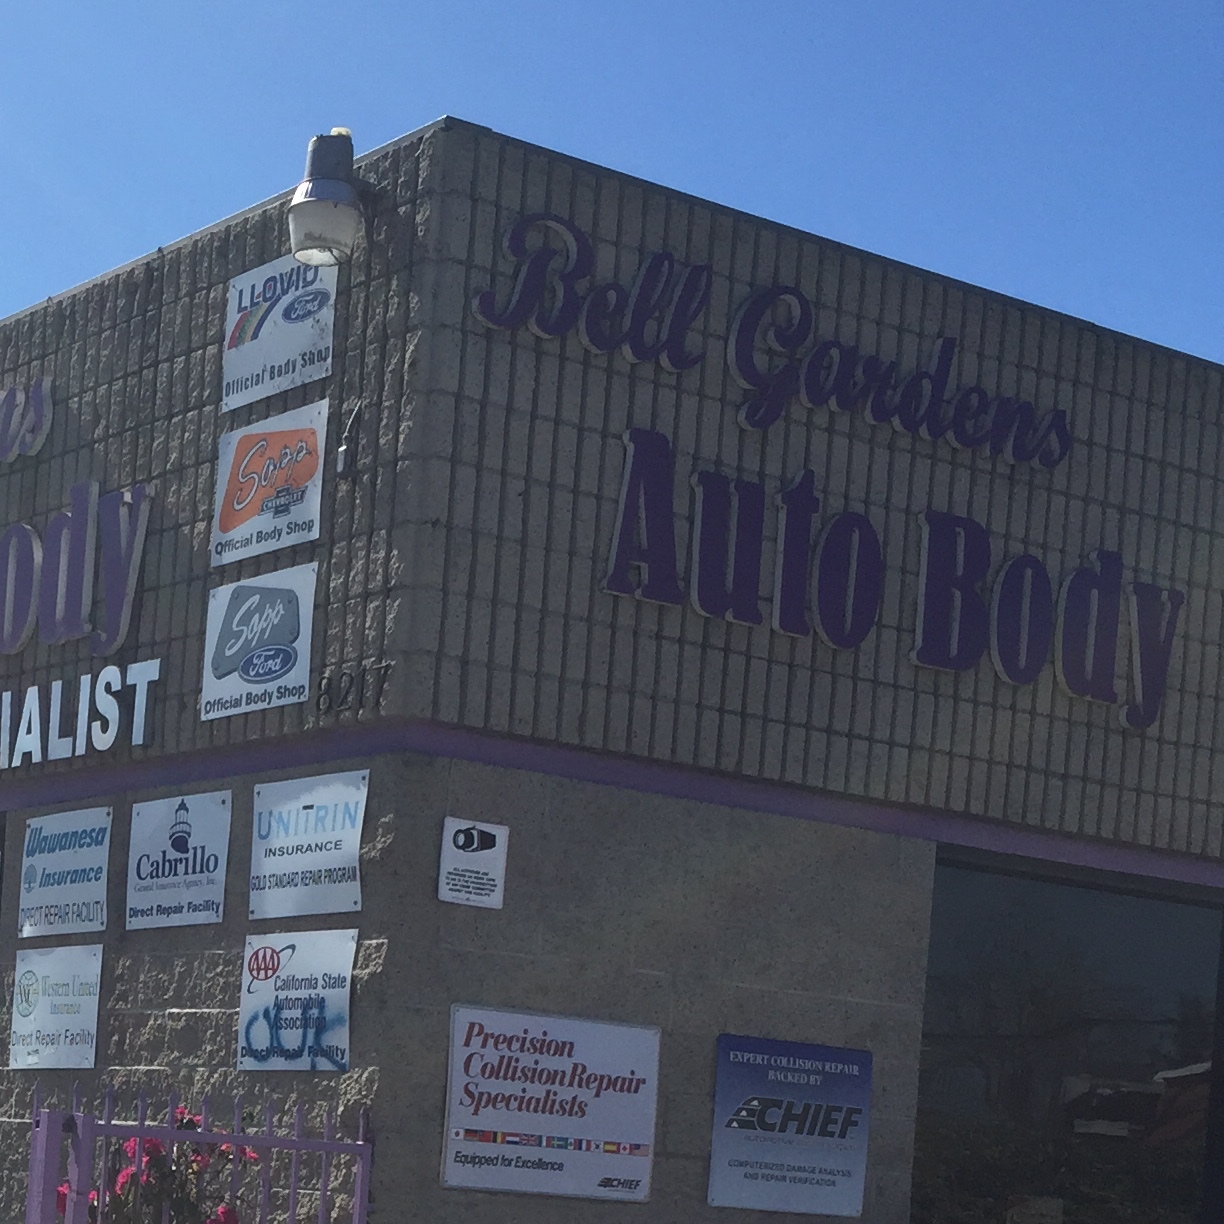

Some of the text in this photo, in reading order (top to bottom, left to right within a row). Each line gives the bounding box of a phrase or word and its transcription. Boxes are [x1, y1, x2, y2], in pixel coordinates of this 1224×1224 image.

[290, 297, 321, 319] Ford
[474, 212, 1074, 468] Bell Gardens
[225, 345, 331, 398] Official Body Shop
[215, 518, 315, 556] Official Body Shop
[602, 427, 1185, 729] Auto Body
[225, 594, 286, 657] Sapp
[249, 650, 284, 676] Ford
[204, 693, 243, 715] Official
[246, 688, 274, 706] Body
[257, 801, 360, 840] UNITRIN
[25, 826, 108, 858] Wawanesa
[264, 840, 343, 858] INSURANCE
[136, 845, 219, 881] Cabrillo
[38, 866, 103, 888] Insurance
[250, 874, 267, 892] GOLD
[268, 870, 300, 890] STANDARD
[301, 868, 323, 887] REPAIR
[44, 903, 70, 925] REPAIR
[72, 900, 105, 923] FACILITY
[129, 899, 221, 919] Direct Repair Facility
[250, 947, 278, 979] AAA
[274, 972, 347, 992] California State
[11, 1028, 95, 1048] Direct Repair Facility
[463, 1021, 575, 1058] Precision
[463, 1052, 646, 1098] Collision Repair
[730, 1051, 860, 1075] EXPERT COLLISION REPAIR
[768, 1070, 823, 1085] BACKED BY
[459, 1081, 588, 1119] Specialists
[744, 1096, 863, 1139] CHIEF
[453, 1151, 564, 1172] Equipped for Excellence
[727, 1159, 785, 1172] COMPUTERIZED
[604, 1177, 642, 1190] CHIEF
